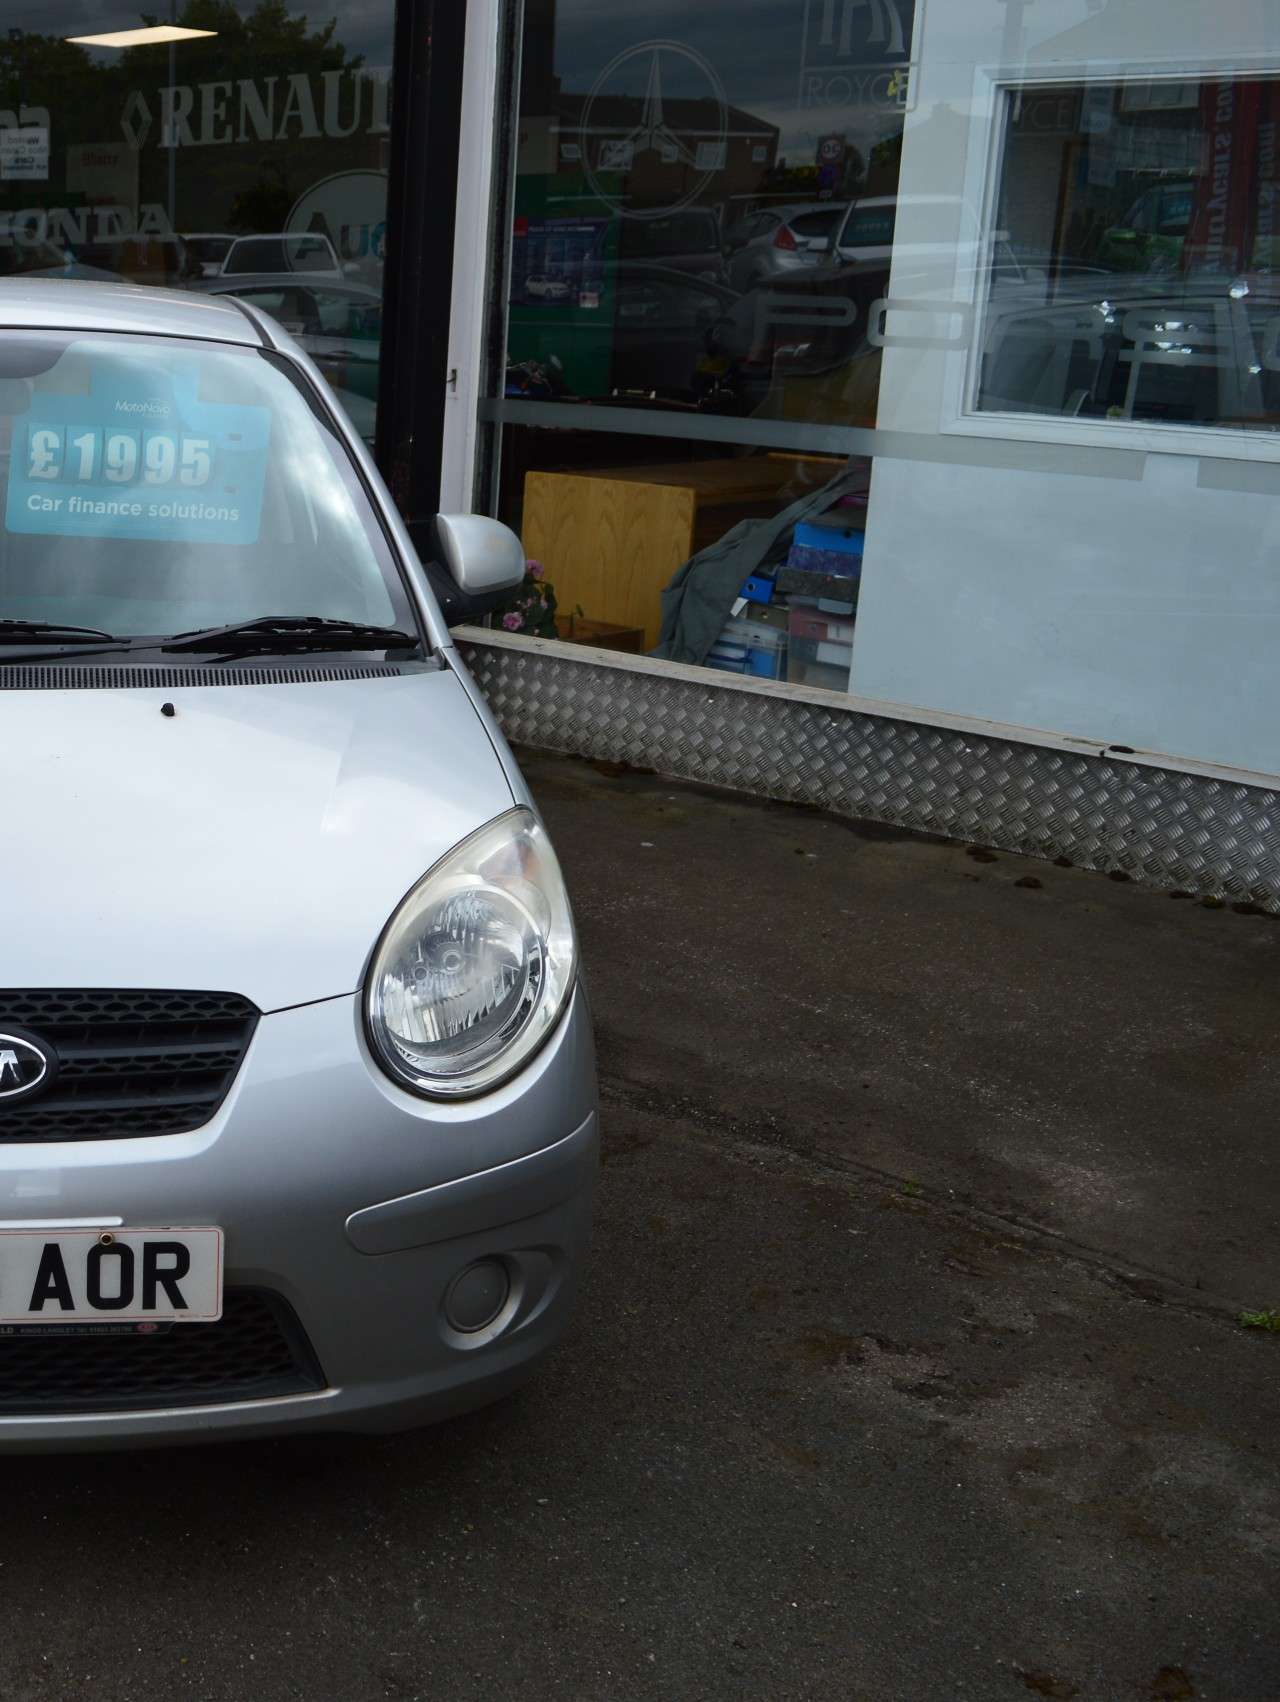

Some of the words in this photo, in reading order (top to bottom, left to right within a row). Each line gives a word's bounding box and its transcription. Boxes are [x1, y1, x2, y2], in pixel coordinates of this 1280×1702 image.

[28, 430, 211, 487] £1995
[27, 494, 62, 513] Car
[68, 496, 143, 517] finance
[148, 501, 241, 522] solutions
[28, 1240, 191, 1312] AOR
